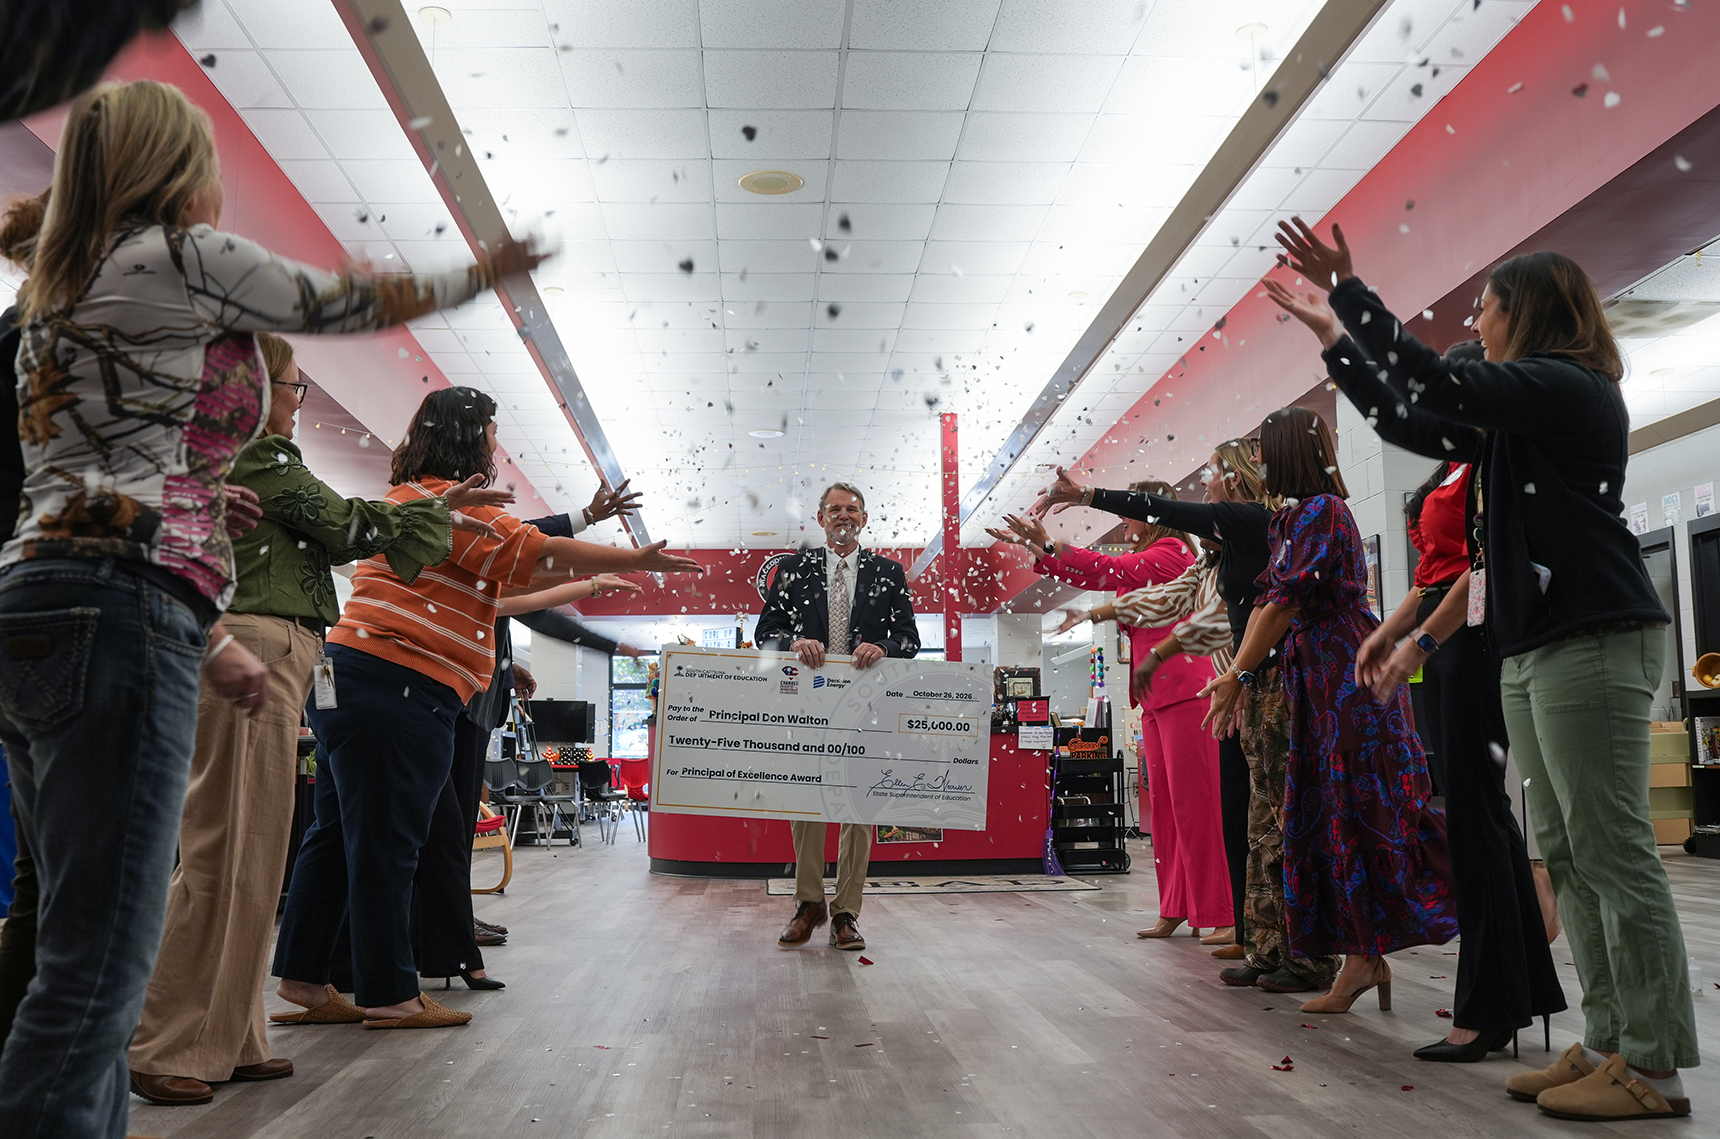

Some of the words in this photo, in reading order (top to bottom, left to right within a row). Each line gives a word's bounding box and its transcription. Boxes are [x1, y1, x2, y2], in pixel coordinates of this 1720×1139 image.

[886, 690, 903, 698] Date
[913, 690, 942, 698] October
[955, 692, 973, 700] 2026
[667, 705, 682, 713] Pay
[692, 705, 705, 713] the
[667, 714, 688, 722] Order
[709, 709, 760, 724] Principal
[763, 713, 785, 723] Don
[787, 714, 829, 726] Walton
[907, 719, 970, 732] $25,000.00
[669, 735, 741, 749] Twenty-Five
[743, 739, 800, 752] Thousand
[802, 743, 825, 753] and
[827, 744, 866, 756] 00/100
[1071, 751, 1107, 759] PARKING
[952, 757, 979, 765] Dollars
[682, 767, 725, 778] Principal
[726, 769, 736, 778] of
[737, 770, 788, 781] Excellence
[790, 773, 822, 783] Award
[872, 790, 888, 798] State
[889, 791, 934, 799] Superintendent
